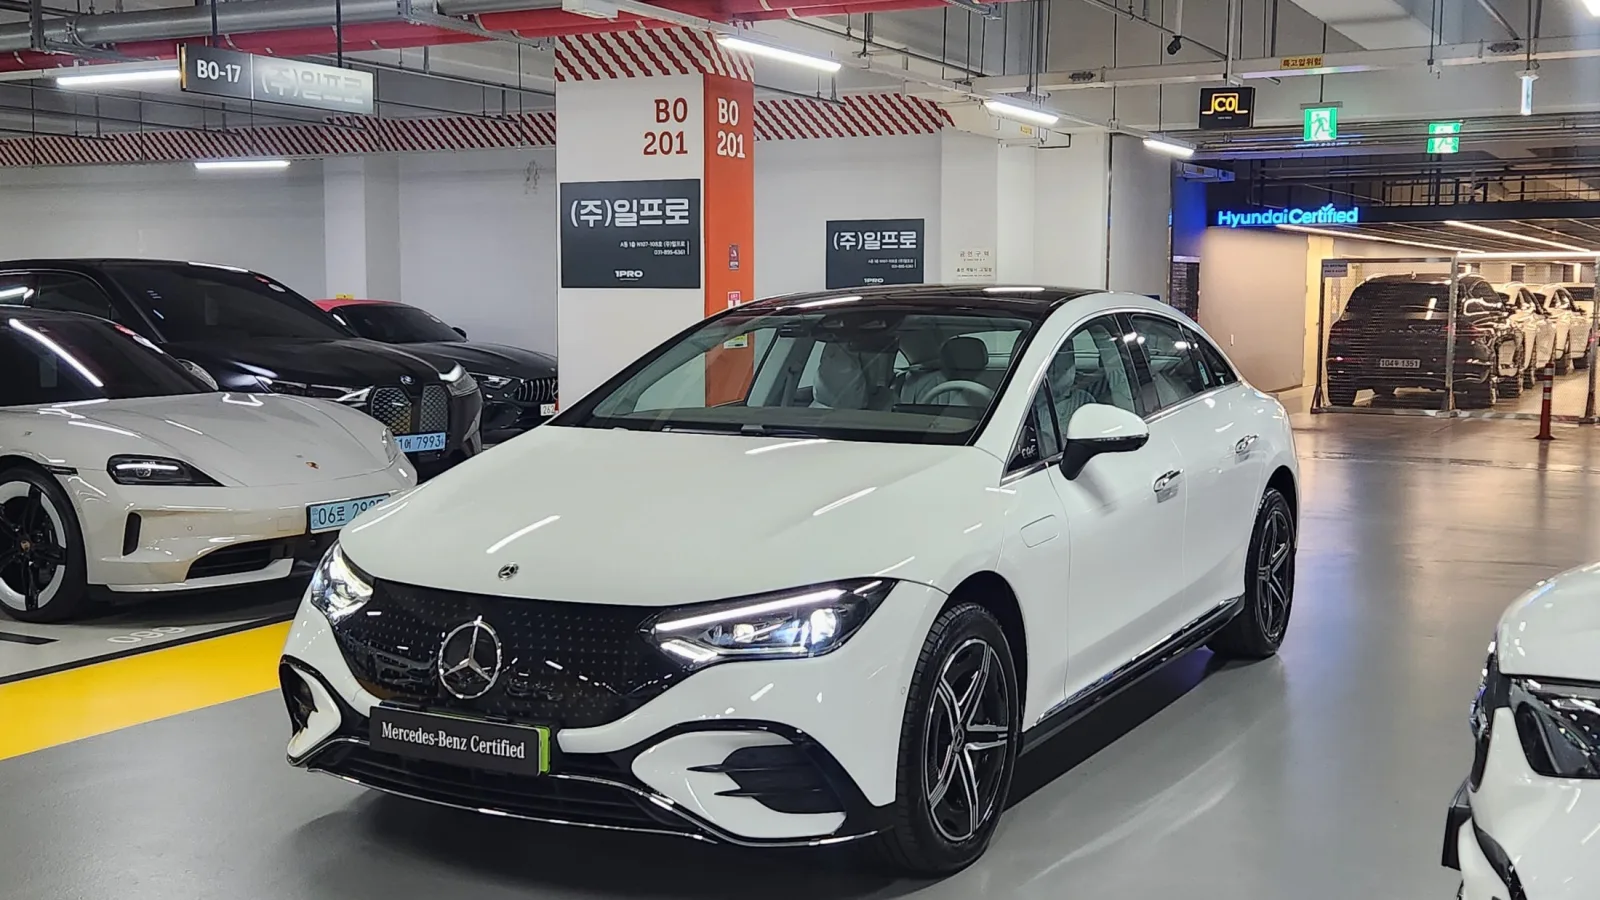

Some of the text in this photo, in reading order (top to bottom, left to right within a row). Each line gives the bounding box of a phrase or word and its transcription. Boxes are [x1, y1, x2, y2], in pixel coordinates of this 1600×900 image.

[261, 66, 364, 105] (주)일프로
[643, 131, 688, 155] 201
[717, 131, 746, 158] 201
[570, 198, 689, 227] (주)일프로
[833, 231, 917, 250] (주)일프로
[614, 270, 643, 278] 1PRO
[395, 438, 412, 450] 1어
[416, 435, 441, 450] 7993
[318, 506, 345, 525] 06로
[352, 499, 384, 519] 29
[381, 721, 525, 759] Mercedes-Benz Certified
